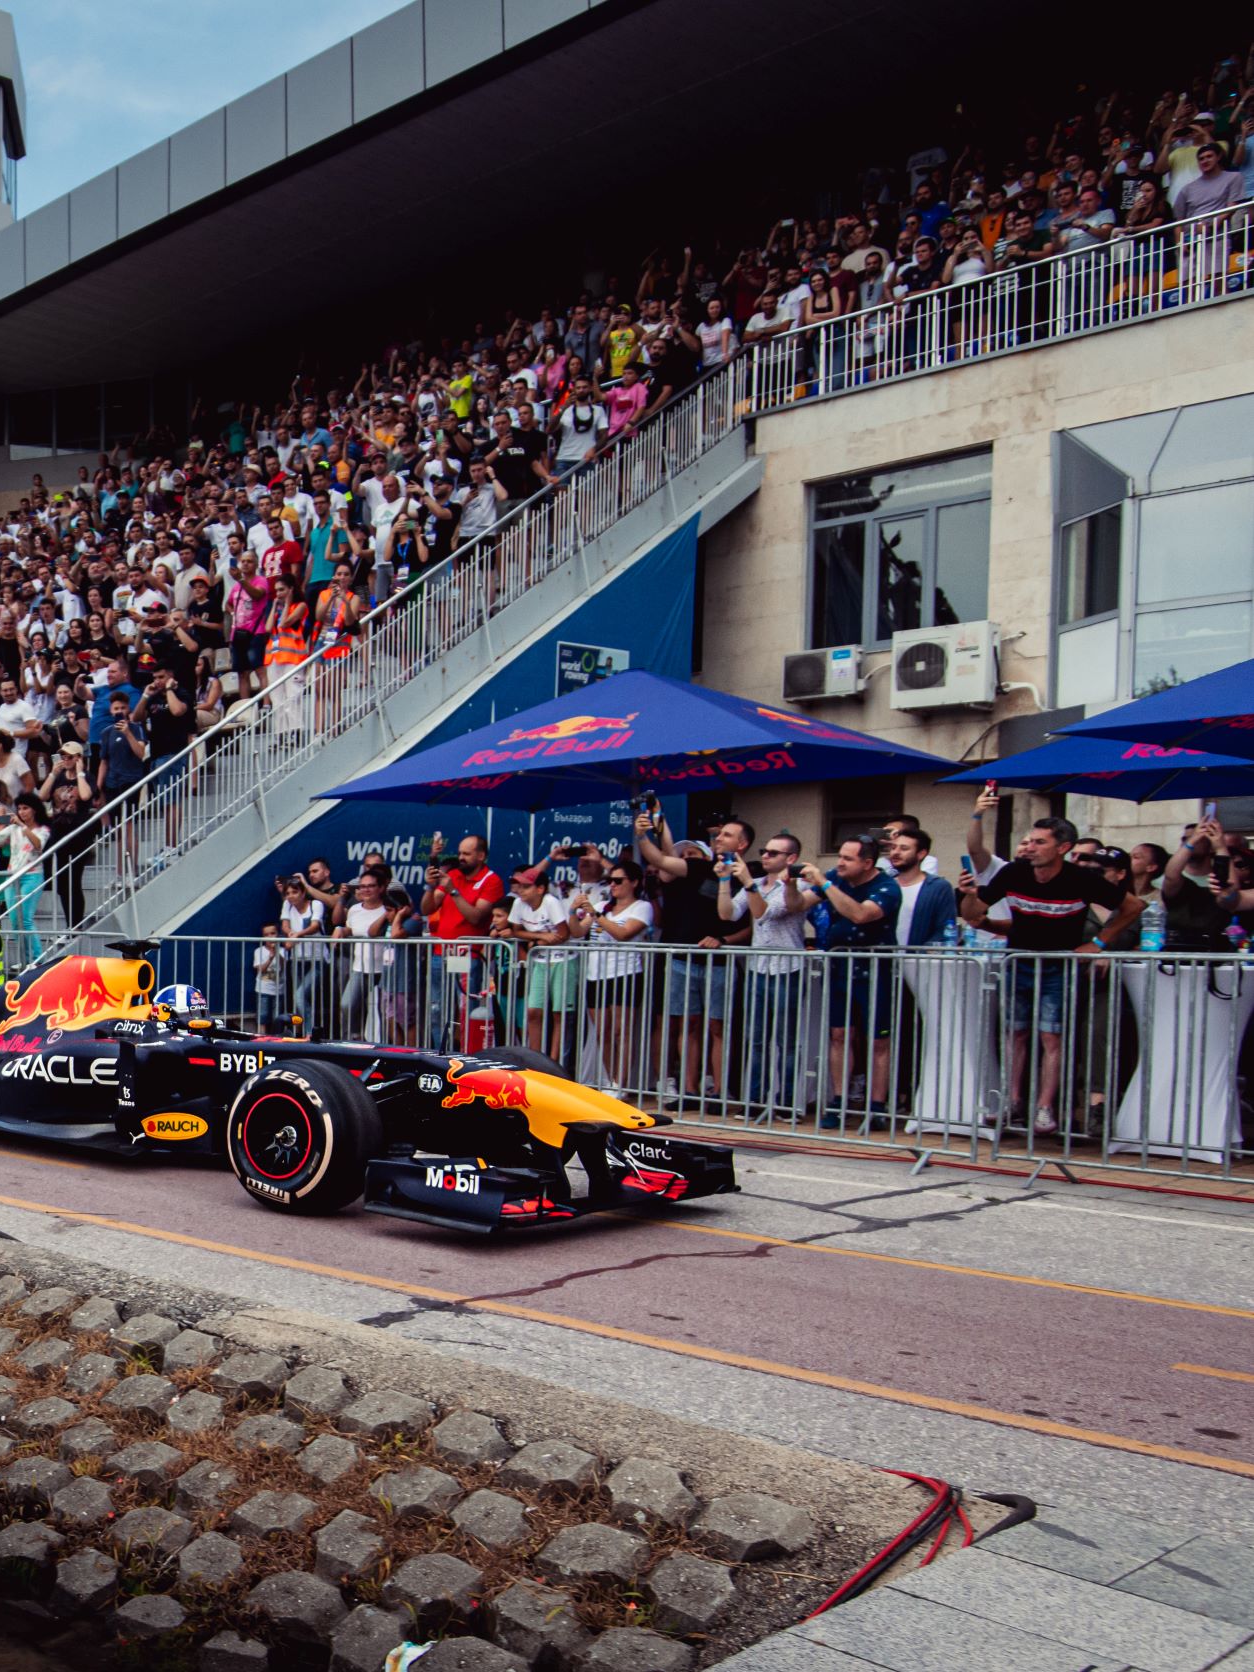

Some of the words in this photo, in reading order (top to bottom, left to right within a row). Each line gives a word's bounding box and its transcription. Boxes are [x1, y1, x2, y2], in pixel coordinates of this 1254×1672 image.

[462, 741, 547, 768] Red
[542, 730, 635, 756] Bull
[347, 835, 415, 862] world
[114, 1019, 147, 1035] citrix
[1, 1054, 120, 1086] ORACLE
[220, 1051, 276, 1074] BYBIT
[265, 1069, 324, 1109] ZERO
[419, 1077, 441, 1089] FIA
[118, 1098, 135, 1107] Tezos
[157, 1120, 199, 1132] RAUCH
[246, 1176, 290, 1204] PIRELLI
[426, 1167, 480, 1195] Mobil
